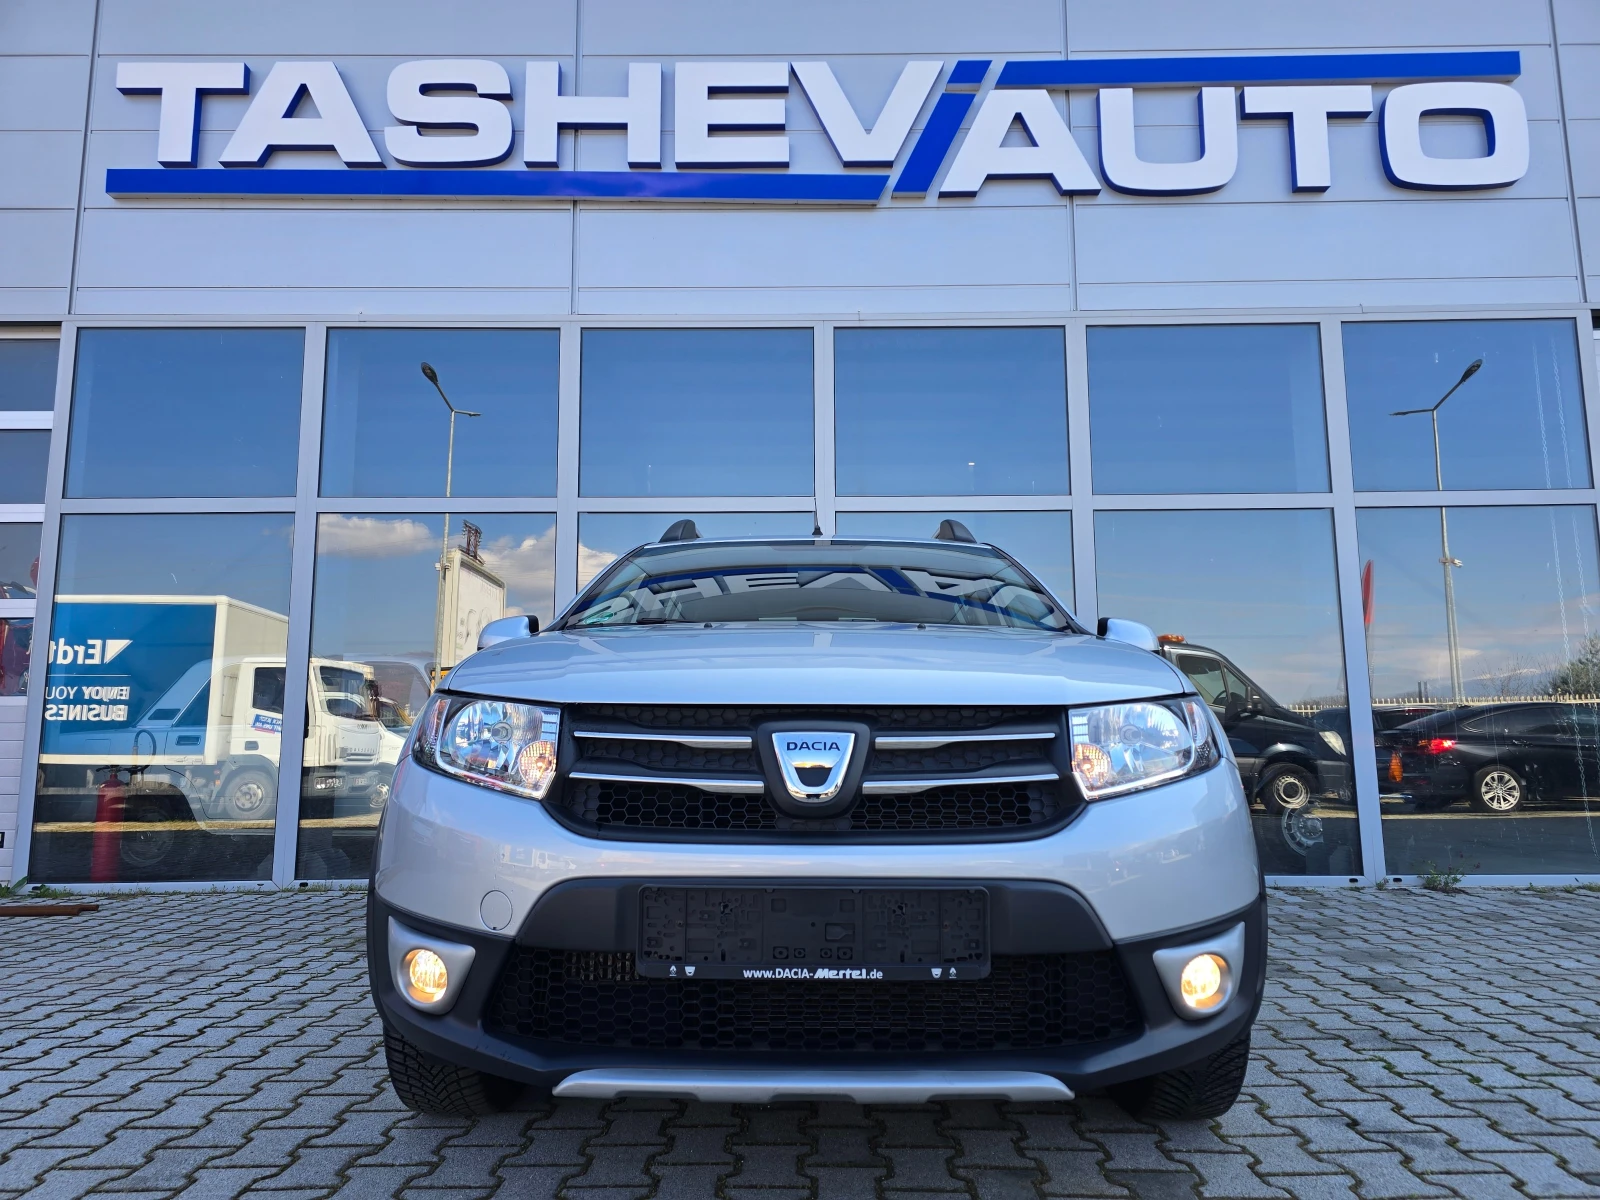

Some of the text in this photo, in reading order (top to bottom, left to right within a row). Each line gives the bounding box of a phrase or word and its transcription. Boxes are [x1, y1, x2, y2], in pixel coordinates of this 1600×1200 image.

[938, 81, 1530, 197] AUTO
[786, 741, 841, 751] DACIA
[743, 968, 884, 979] www.DACIA-Mertel.de
